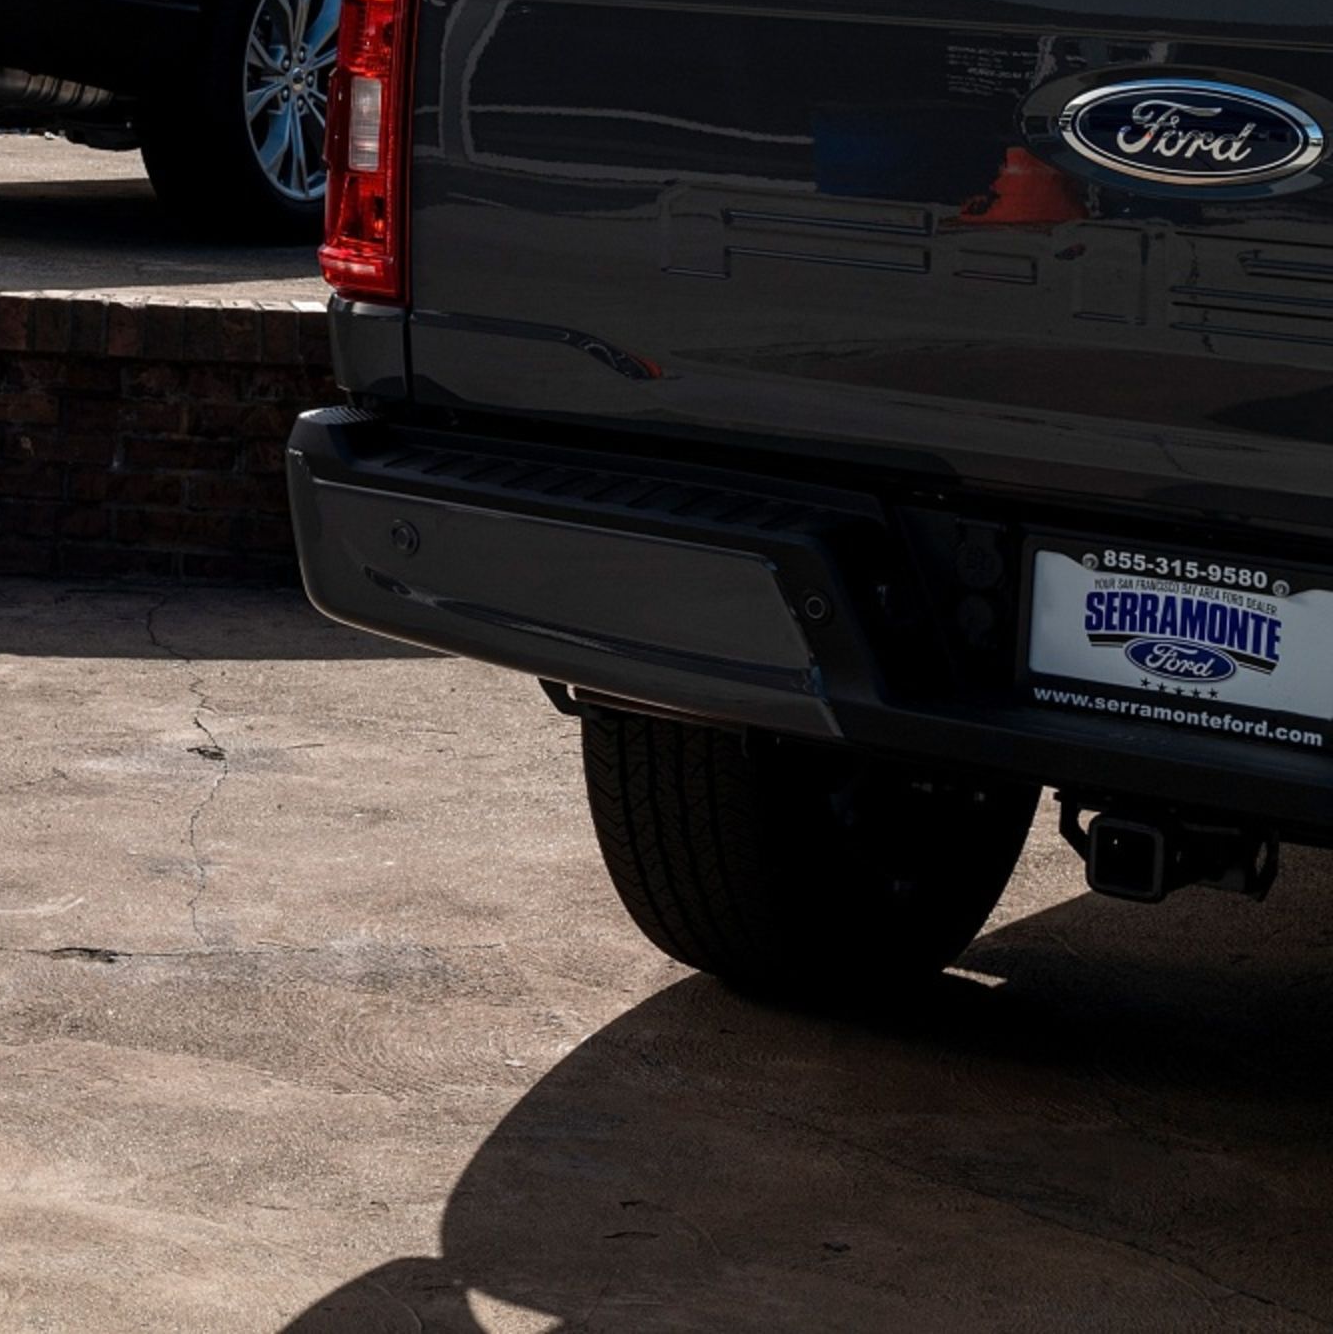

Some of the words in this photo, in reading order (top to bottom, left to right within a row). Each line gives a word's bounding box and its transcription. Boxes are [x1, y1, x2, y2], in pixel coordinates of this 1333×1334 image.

[1116, 98, 1257, 164] Ford
[1103, 550, 1268, 589] 855-315-9580
[1094, 578, 1116, 590] YOUR
[1117, 578, 1133, 590] SAN
[1135, 579, 1180, 595] FRANCISCO
[1182, 583, 1198, 597] BAY
[1199, 585, 1221, 601] AREA
[1222, 590, 1244, 607] FORD
[1246, 596, 1278, 616] DEALER
[1085, 591, 1282, 661] SERRAMONTE
[1144, 642, 1215, 679] Ford
[1033, 686, 1324, 747] www.serramonteford.com
